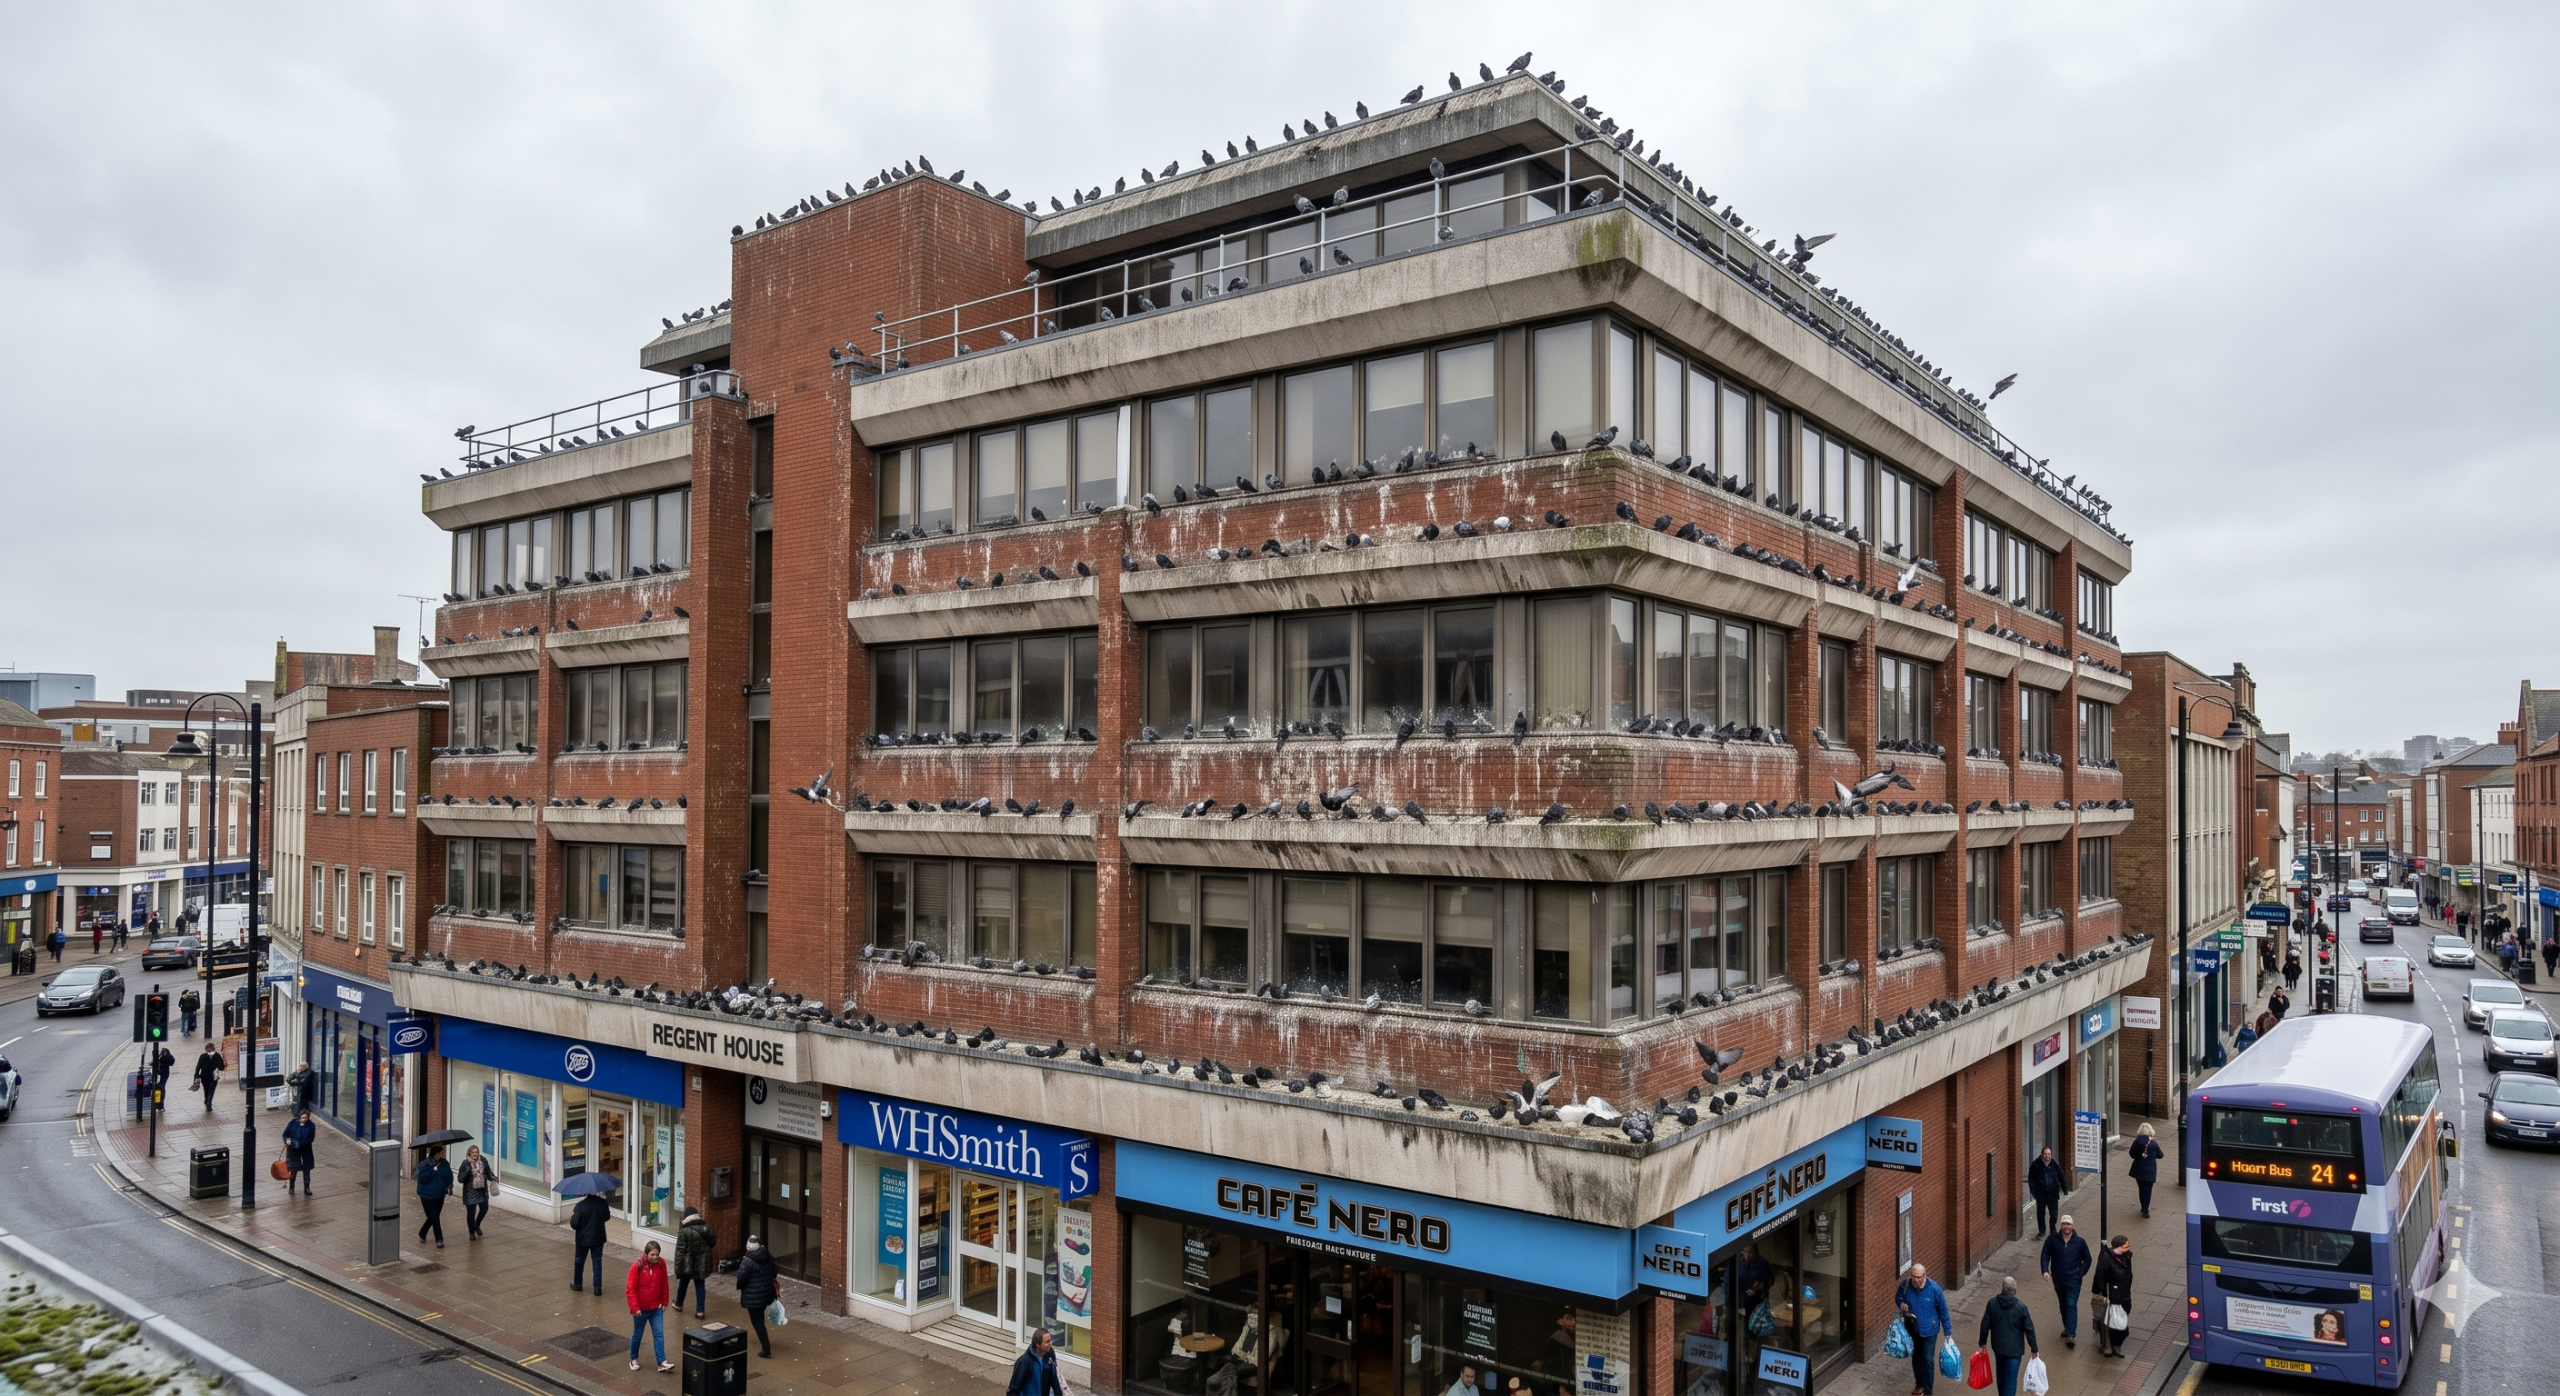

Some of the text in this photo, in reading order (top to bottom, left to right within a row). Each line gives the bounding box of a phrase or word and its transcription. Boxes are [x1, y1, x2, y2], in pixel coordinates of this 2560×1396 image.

[653, 1022, 784, 1066] REGENT HOUSE
[869, 1101, 1044, 1178] WHSmith
[1869, 1136, 1918, 1154] NERO
[1070, 1152, 1089, 1194] S
[2269, 1164, 2292, 1177] Bus
[2312, 1164, 2333, 1184] 24
[1726, 1167, 1776, 1232] CAFÉ
[1779, 1152, 1826, 1205] NERO
[1216, 1177, 1450, 1253] CAFÉ NERO
[2252, 1197, 2288, 1215] First
[1655, 1243, 1692, 1259] CAFÉ
[1642, 1253, 1702, 1279] NERO
[1764, 1363, 1800, 1380] NERO
